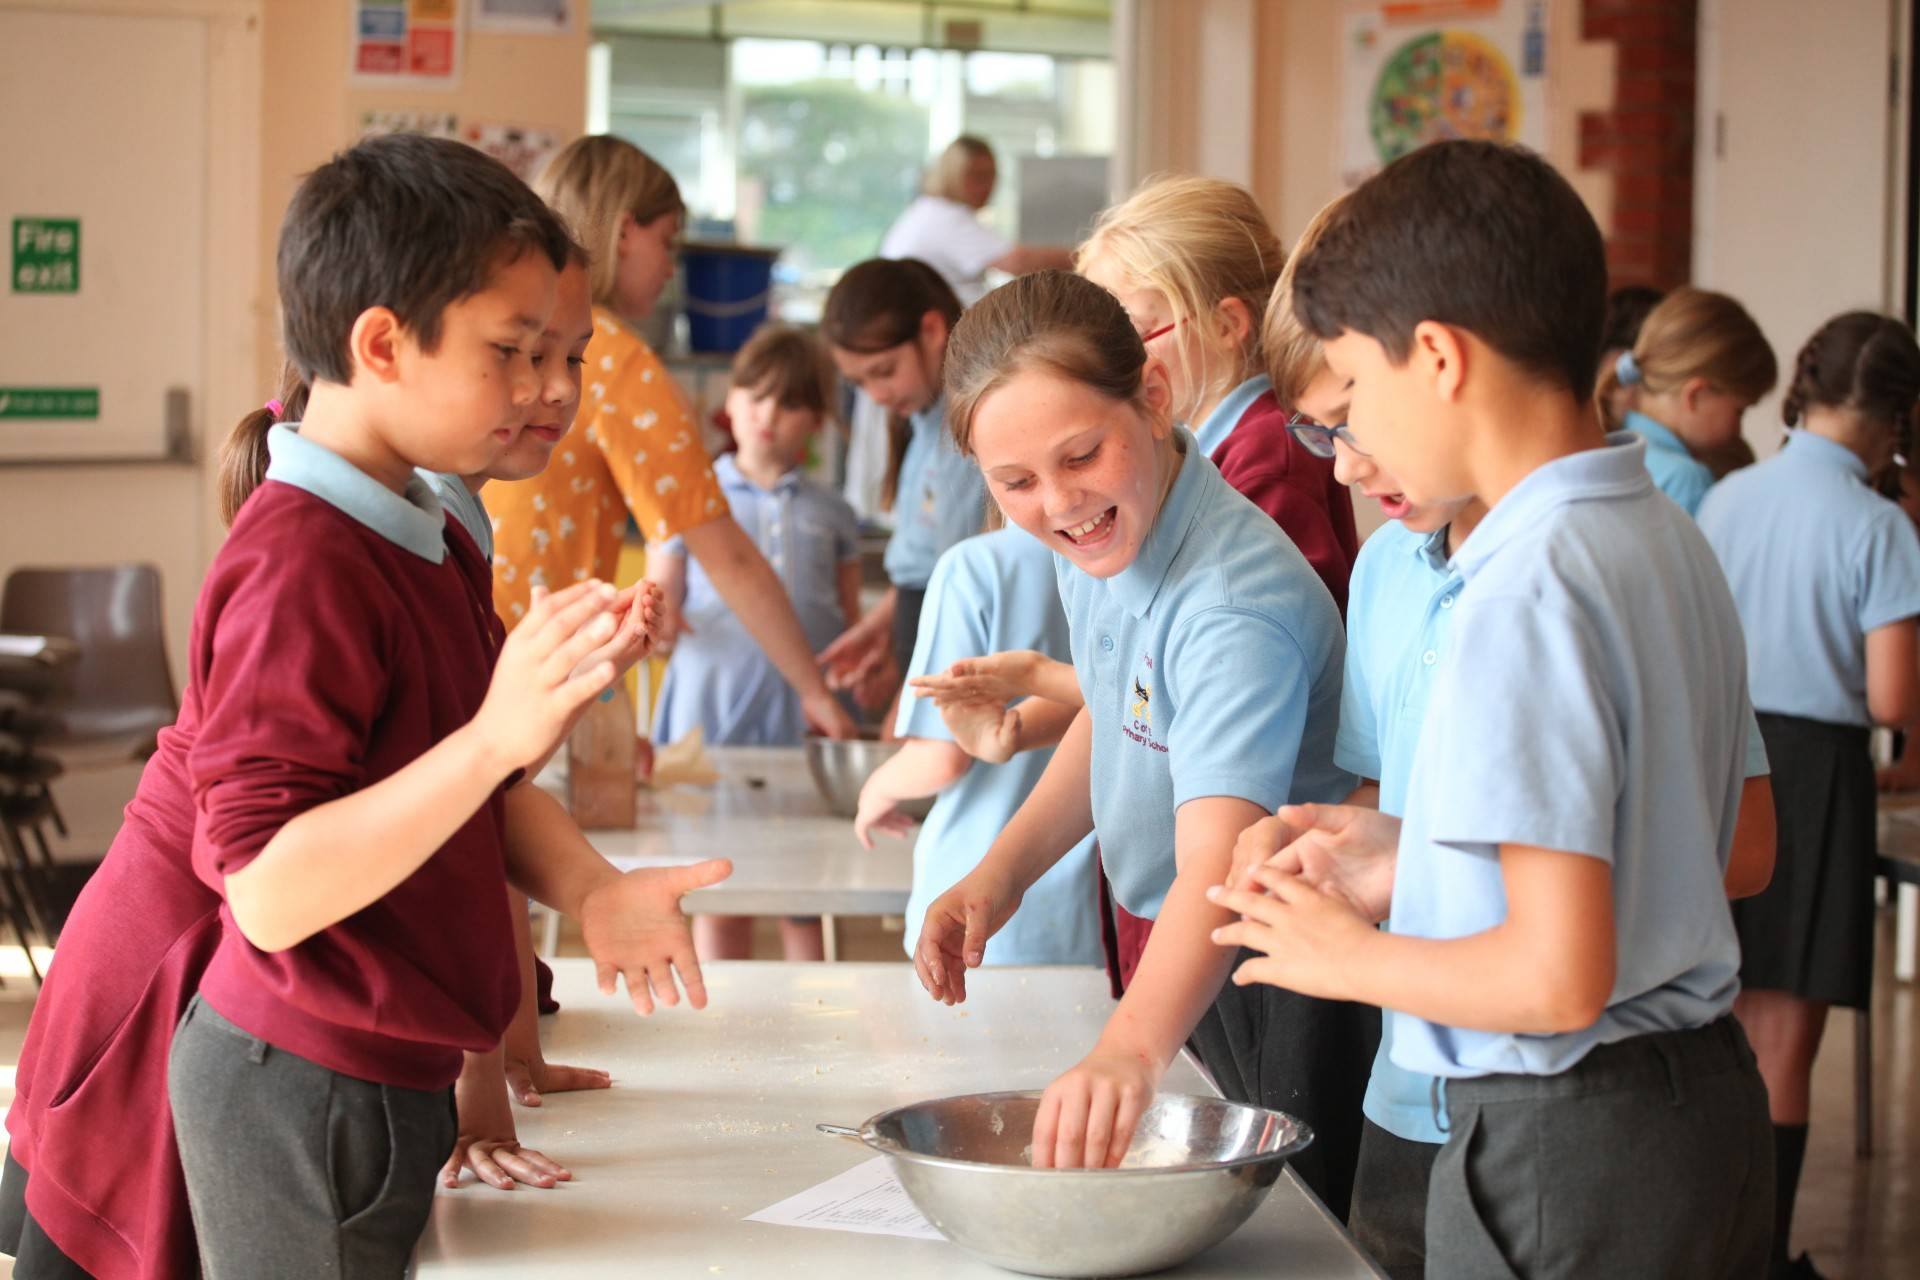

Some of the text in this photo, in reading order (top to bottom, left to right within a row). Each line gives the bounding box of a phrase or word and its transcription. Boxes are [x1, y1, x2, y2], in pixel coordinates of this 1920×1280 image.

[18, 222, 73, 252] Fire
[18, 260, 73, 289] exit
[1122, 724, 1147, 746] Primary
